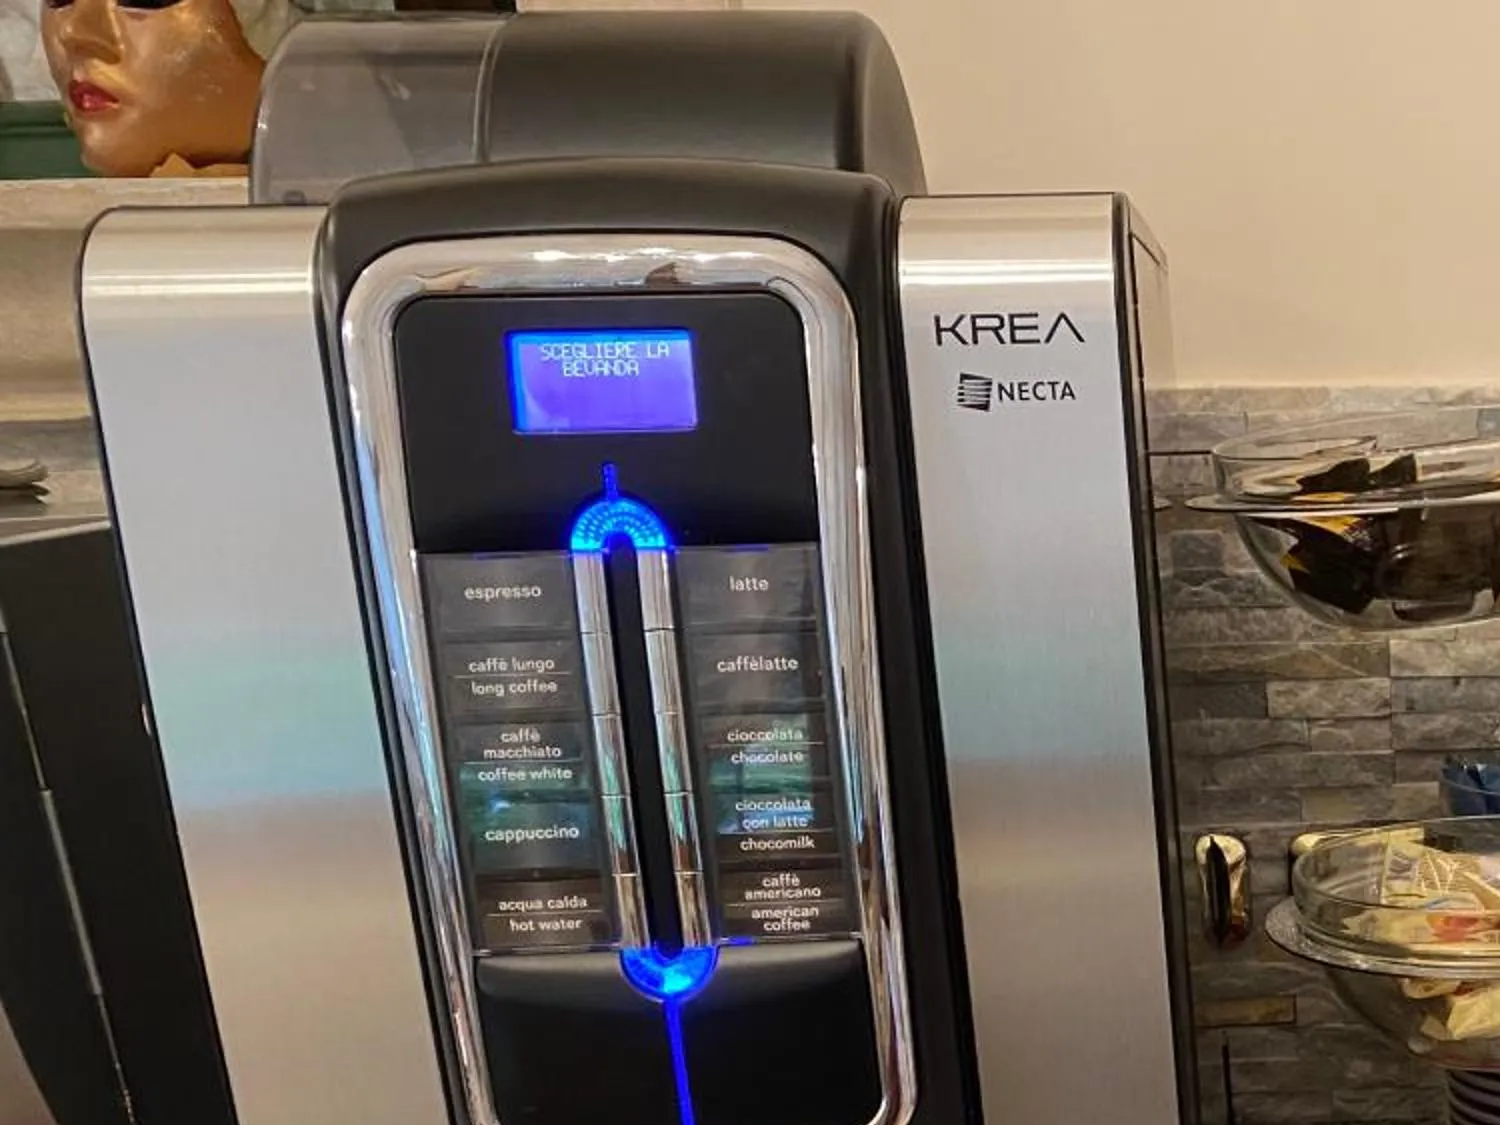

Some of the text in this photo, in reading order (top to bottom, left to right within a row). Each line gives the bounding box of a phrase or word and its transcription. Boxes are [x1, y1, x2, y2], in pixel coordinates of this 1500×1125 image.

[933, 312, 1085, 346] KREA
[540, 341, 670, 360] SCEGLIERE LA
[562, 359, 640, 377] BEVANDA
[997, 381, 1076, 401] NECTA
[729, 575, 769, 592] latte
[464, 585, 542, 602] espresso
[511, 656, 555, 674] lungo
[717, 655, 799, 672] caffèlatte
[471, 678, 558, 697] long coffee
[727, 728, 804, 742] cioccolata
[483, 745, 562, 760] macchiato
[731, 749, 804, 764] chocolate
[477, 766, 573, 782] coffee white
[735, 797, 813, 812] cioccolata
[742, 814, 809, 830] con latte
[485, 824, 580, 844] cappuccino
[740, 835, 815, 851] chocomilk
[744, 887, 821, 901] americano
[498, 895, 588, 912] acqua calda
[751, 906, 819, 919] american
[509, 919, 583, 932] hot water
[763, 918, 811, 931] coffee
